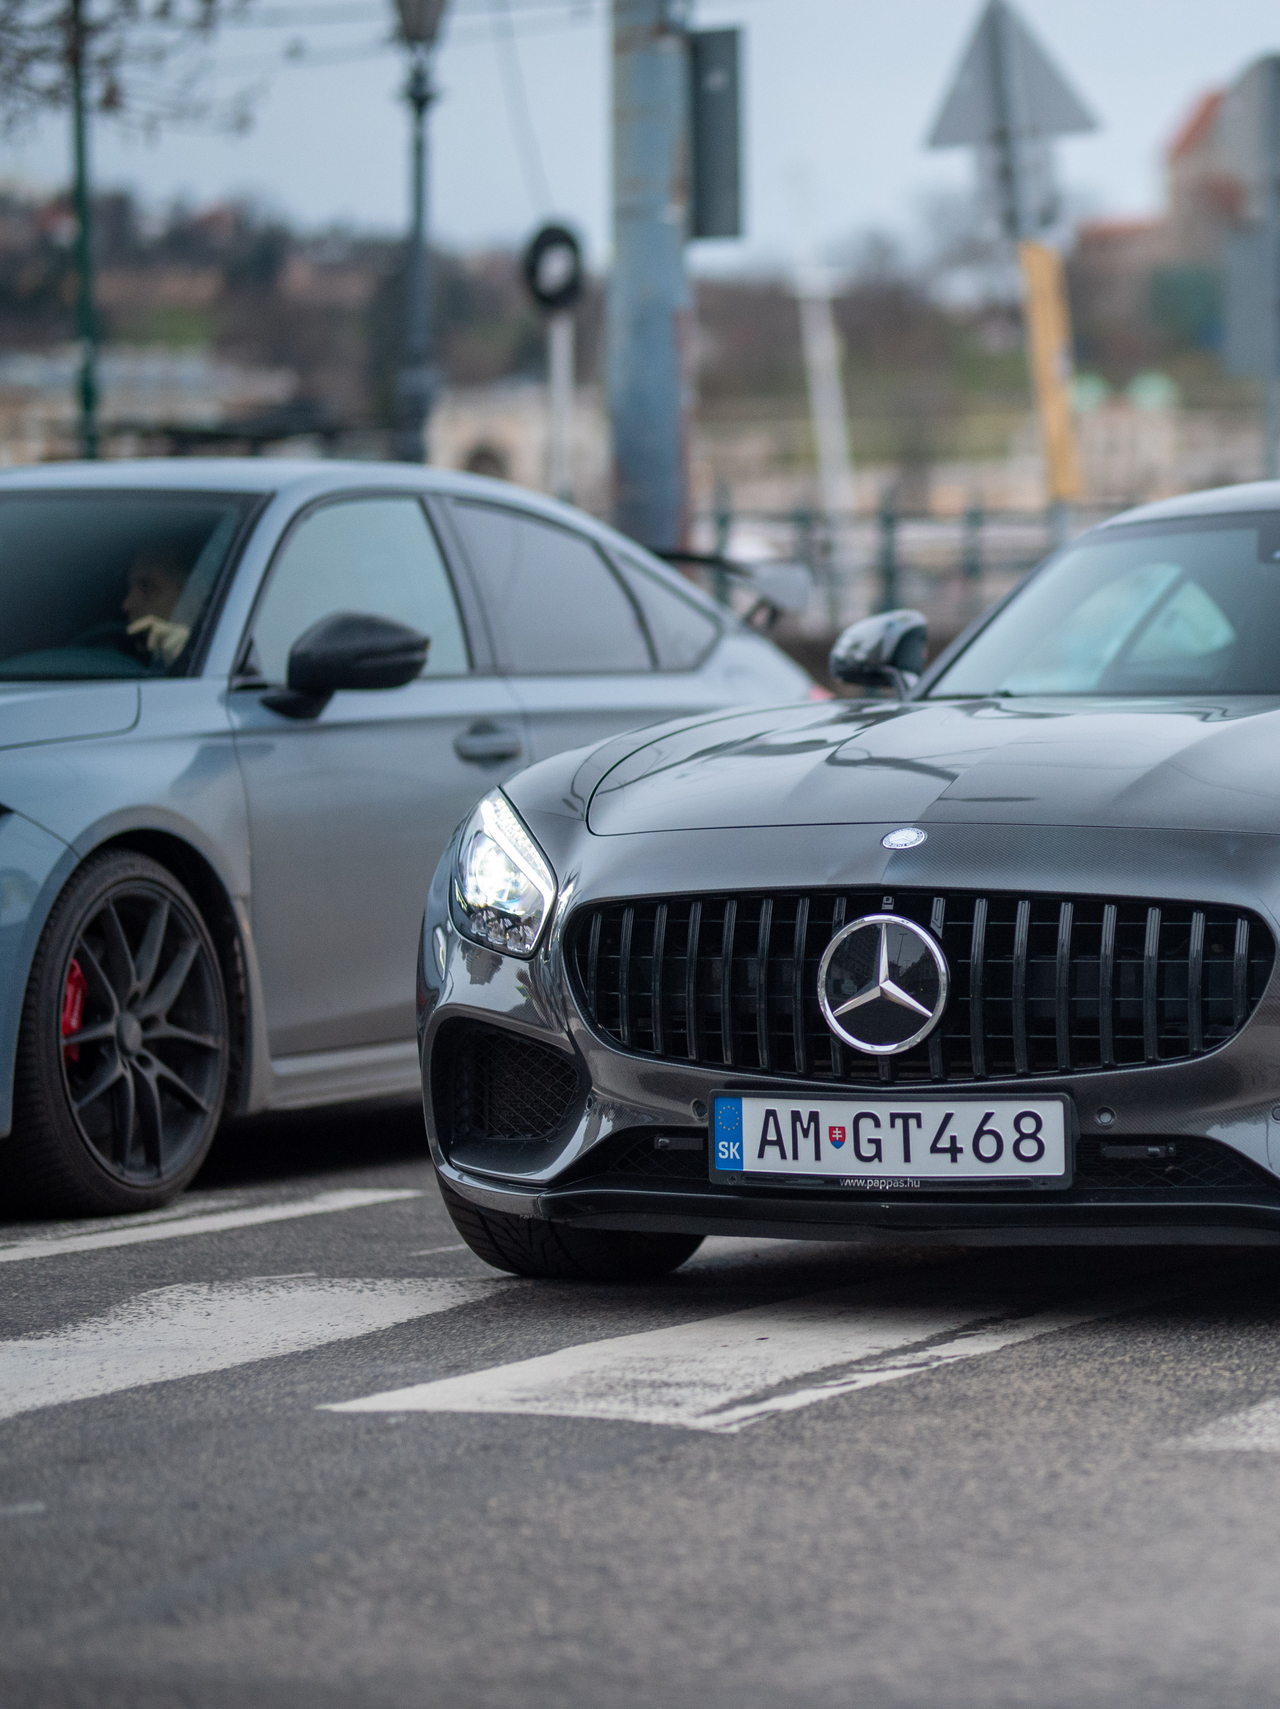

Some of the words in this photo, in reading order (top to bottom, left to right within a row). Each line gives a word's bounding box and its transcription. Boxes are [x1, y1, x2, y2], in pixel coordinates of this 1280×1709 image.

[756, 1108, 822, 1161] AM
[852, 1110, 1046, 1163] GT468
[718, 1141, 741, 1159] SK
[840, 1178, 920, 1190] www.pappas.hu
